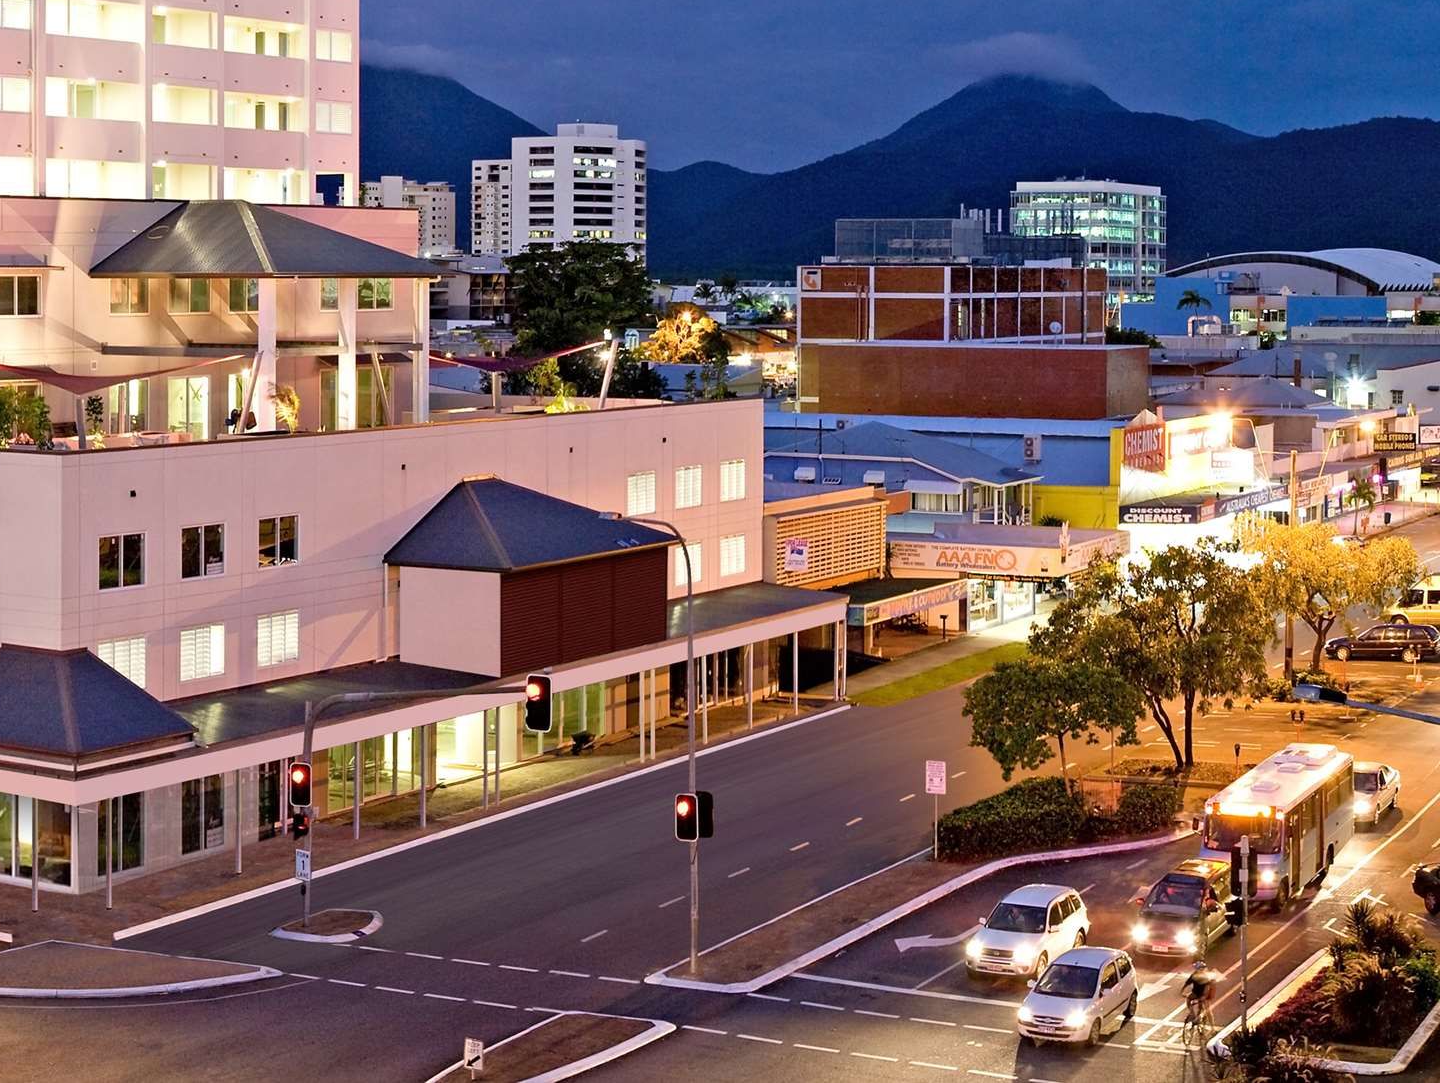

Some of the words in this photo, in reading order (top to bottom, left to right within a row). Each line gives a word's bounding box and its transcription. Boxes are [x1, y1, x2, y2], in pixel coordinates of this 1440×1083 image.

[1125, 428, 1164, 456] CHEMIST
[1123, 514, 1192, 523] CHEMIST
[937, 550, 972, 564] AAA
[936, 561, 959, 569] Battery
